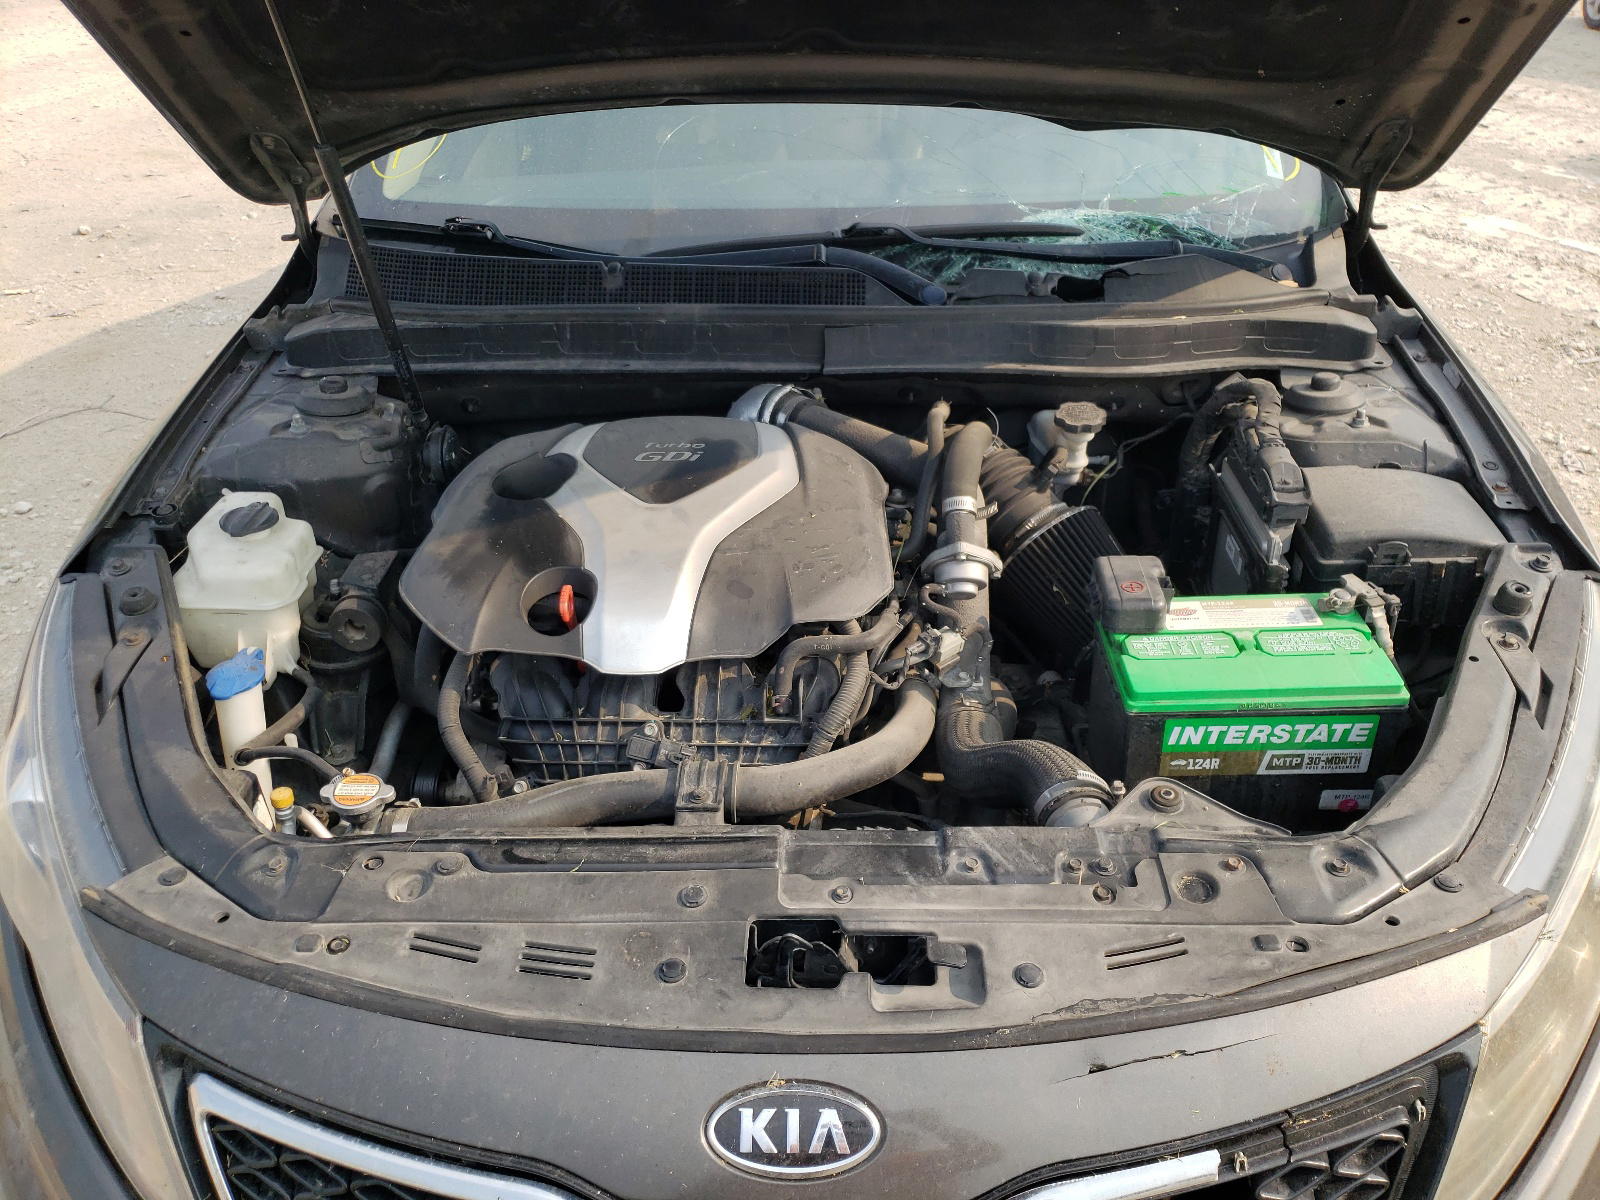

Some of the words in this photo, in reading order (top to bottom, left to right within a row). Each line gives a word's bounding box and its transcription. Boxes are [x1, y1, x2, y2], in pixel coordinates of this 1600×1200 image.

[634, 451, 705, 462] GDi
[1167, 723, 1374, 746] INTERSTATE
[1187, 758, 1221, 770] 124R
[1272, 758, 1301, 767] MTP
[1305, 756, 1362, 766] 30-MONTH
[738, 1107, 851, 1154] KIA
